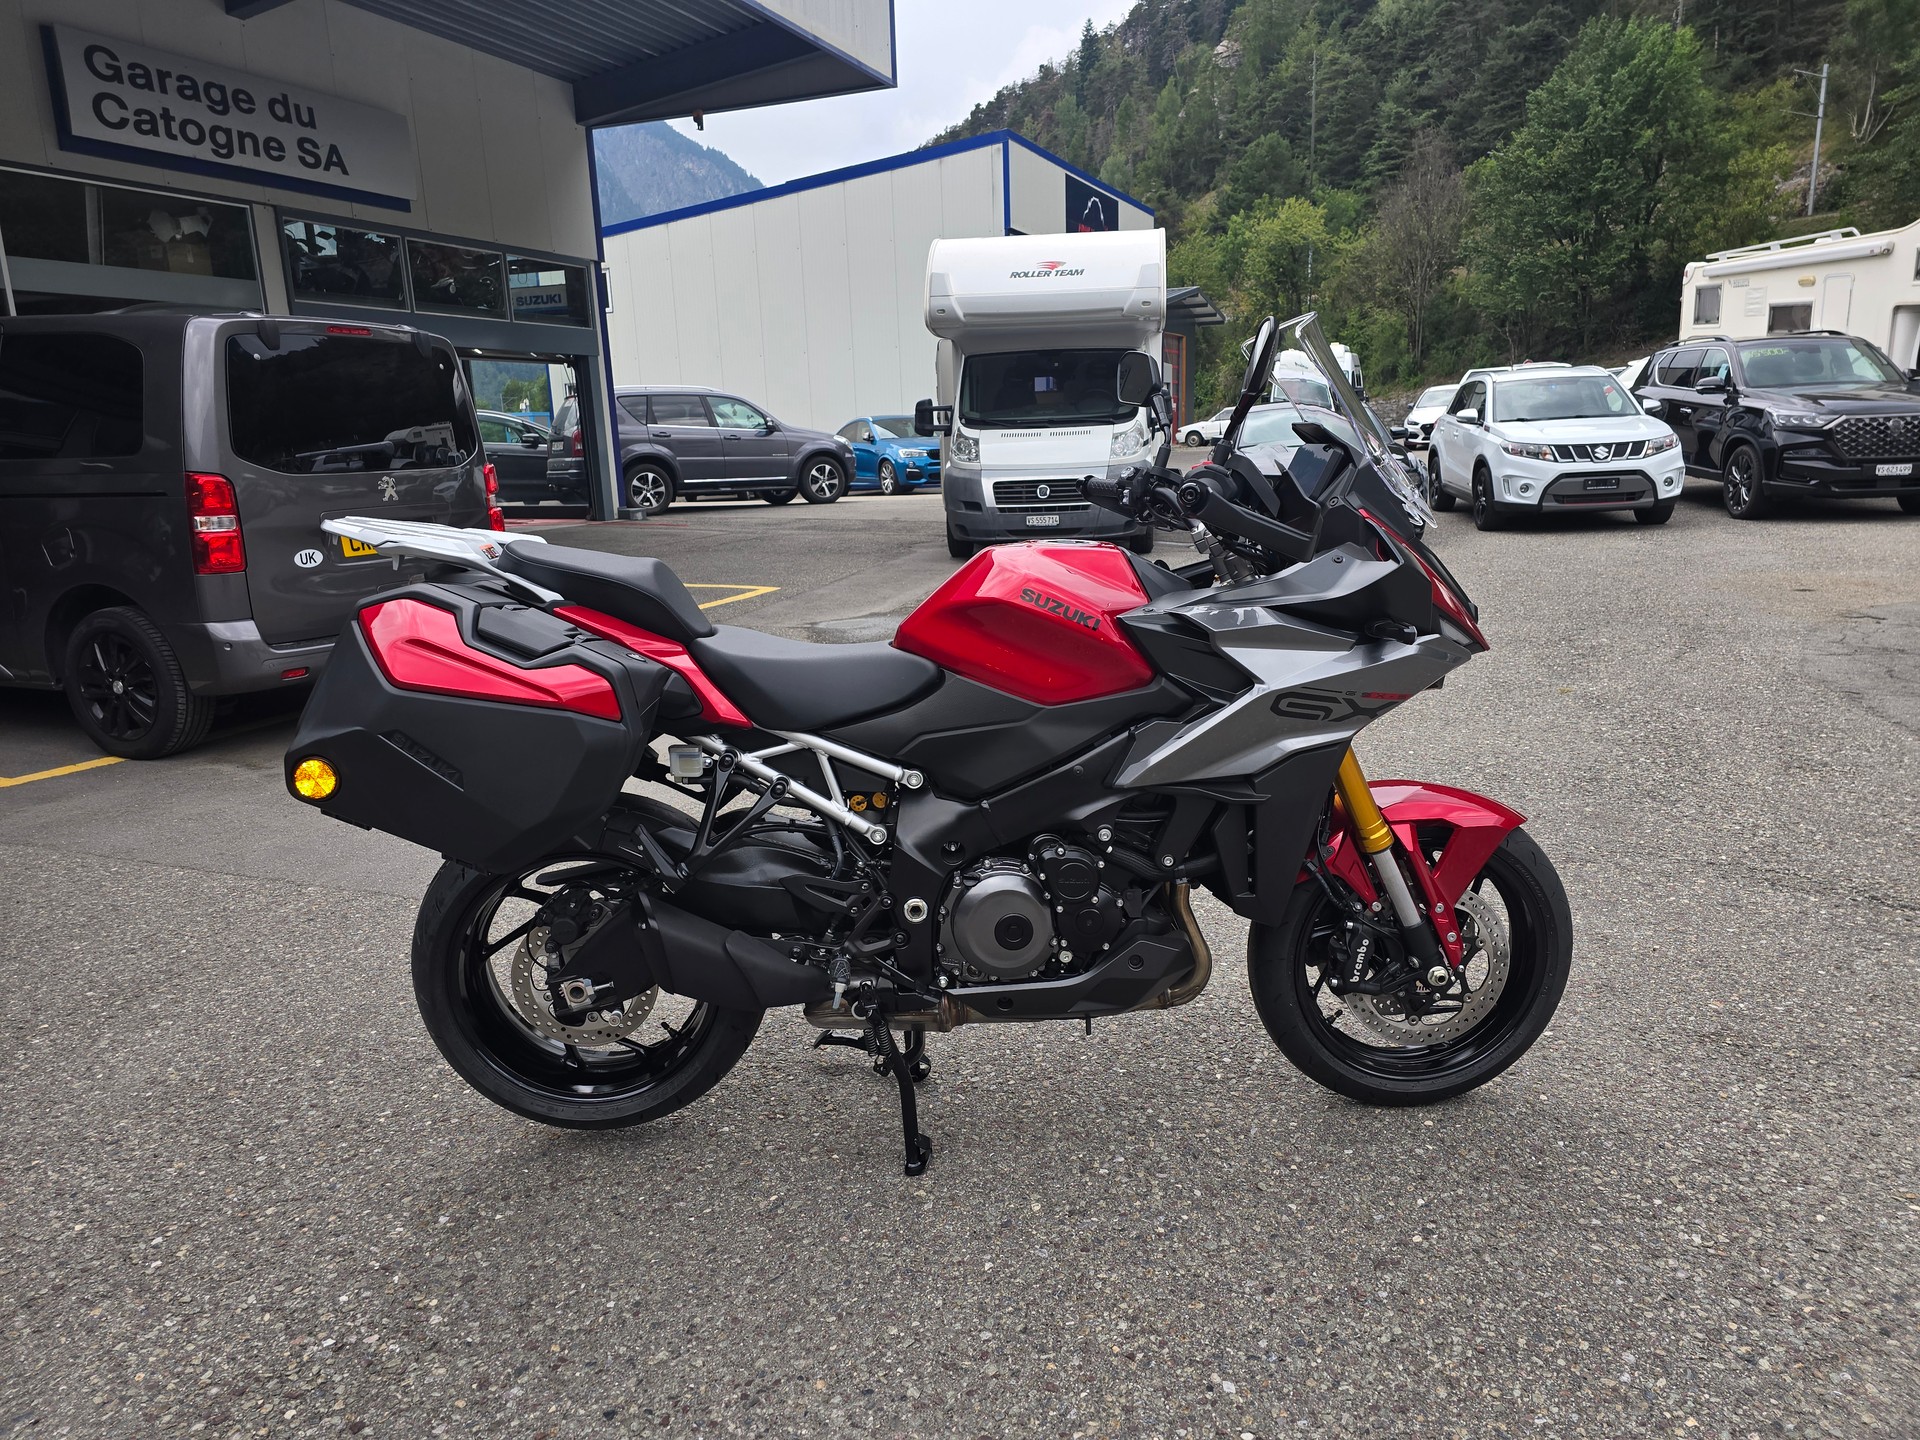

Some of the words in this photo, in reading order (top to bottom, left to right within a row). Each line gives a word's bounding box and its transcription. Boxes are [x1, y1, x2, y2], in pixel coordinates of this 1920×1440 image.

[83, 44, 256, 116] Garage
[267, 92, 317, 130] du
[92, 91, 287, 162] Catogne
[296, 136, 350, 176] SA
[1009, 270, 1053, 278] ROLLER
[1054, 268, 1085, 276] TEAM
[516, 293, 562, 306] SUZUKI
[299, 551, 317, 565] UK
[1019, 587, 1101, 631] SUZUKI
[1349, 939, 1370, 983] brembo
